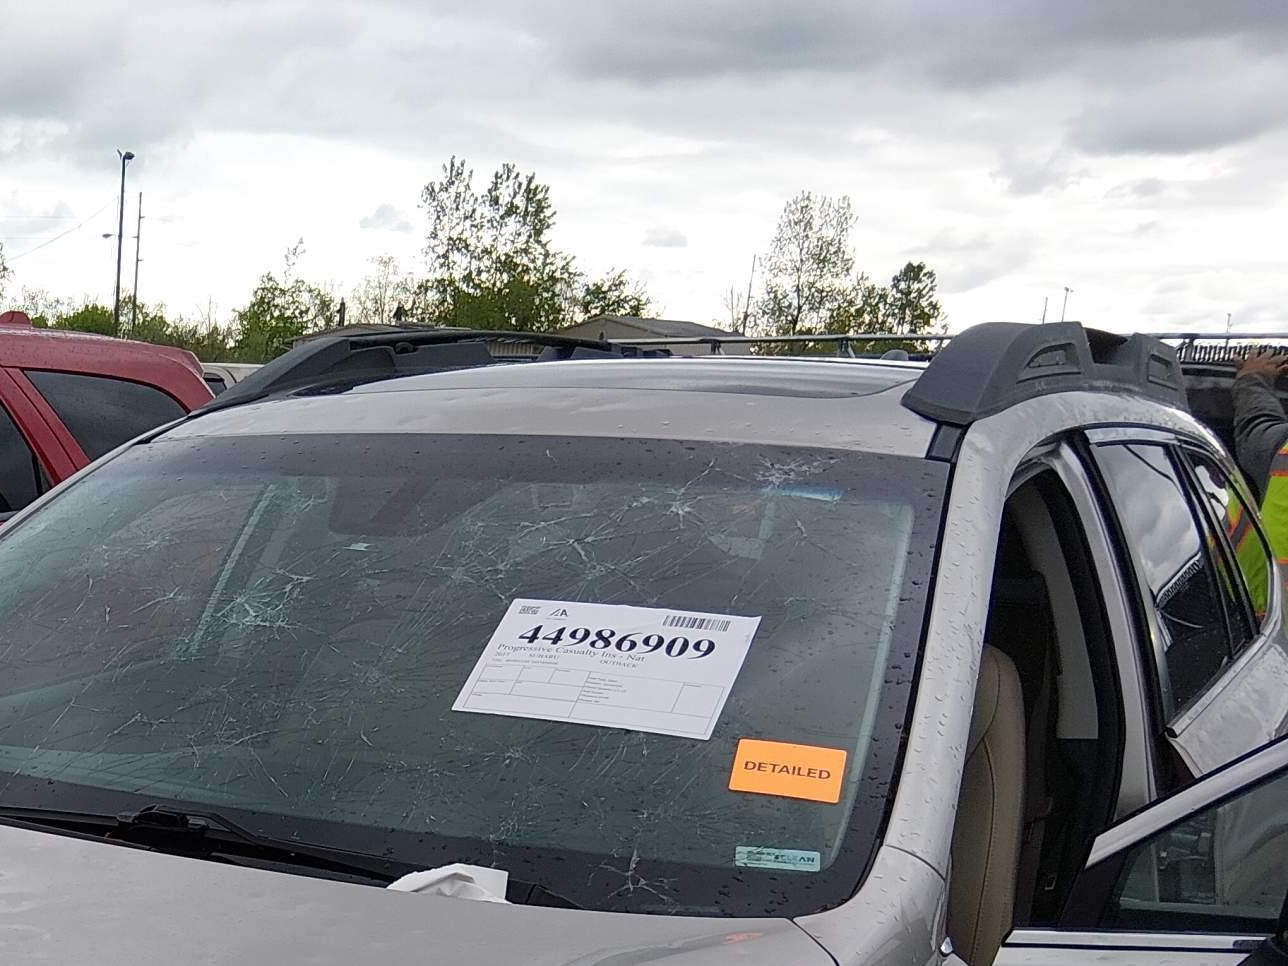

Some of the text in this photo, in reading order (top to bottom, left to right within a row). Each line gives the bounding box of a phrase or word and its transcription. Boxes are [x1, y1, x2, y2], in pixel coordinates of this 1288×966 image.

[498, 643, 552, 653] Progressive
[555, 647, 597, 658] Casualty
[518, 624, 716, 660] 44986909
[743, 760, 832, 780] DETAILED
